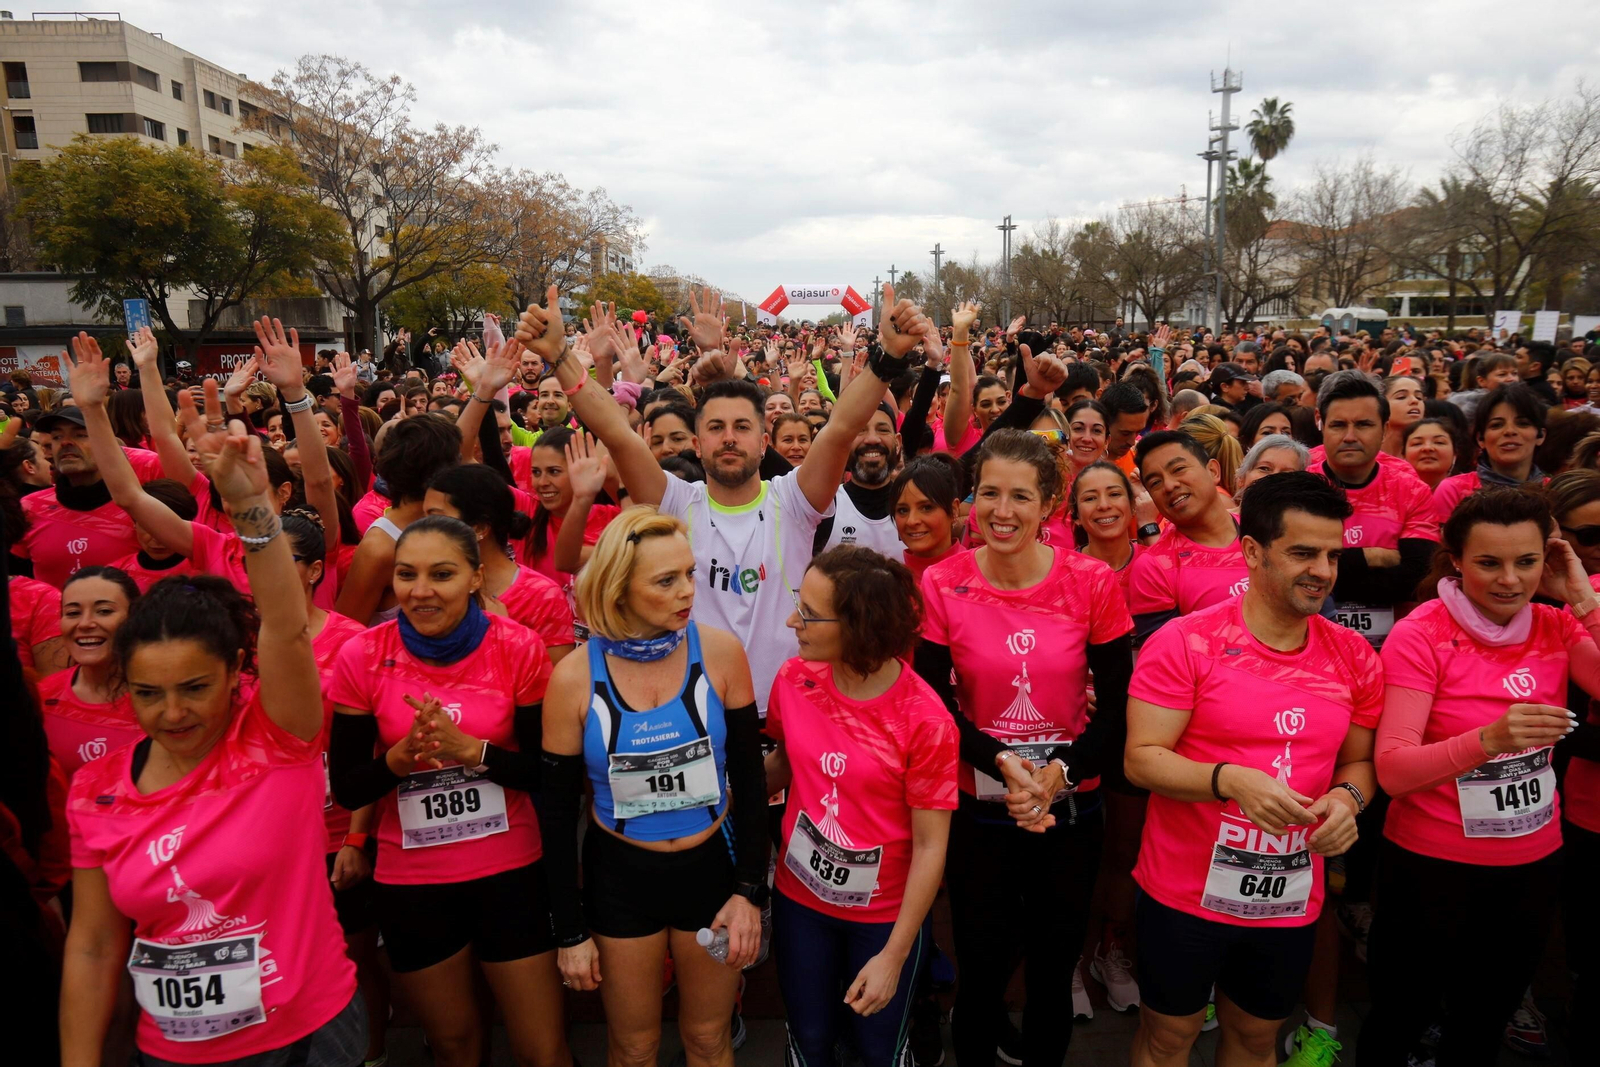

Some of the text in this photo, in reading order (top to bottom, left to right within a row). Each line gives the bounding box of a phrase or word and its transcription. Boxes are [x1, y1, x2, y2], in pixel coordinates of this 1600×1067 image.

[790, 288, 830, 299] cajasur
[1338, 613, 1372, 630] 545
[992, 720, 1054, 731] VIII EDICIÓN
[631, 731, 680, 746] TROTASIERRA
[645, 771, 686, 792] 191
[420, 788, 481, 820] 1389
[1489, 778, 1541, 811] 1419
[1514, 808, 1531, 816] RAQUEL
[1218, 821, 1308, 854] PINK
[810, 849, 850, 886] 839
[1239, 874, 1287, 898] 640
[159, 915, 247, 946] VIII EDICIÓN
[167, 952, 198, 960] BUENOS
[185, 960, 206, 968] MAR
[152, 974, 226, 1009] 1054
